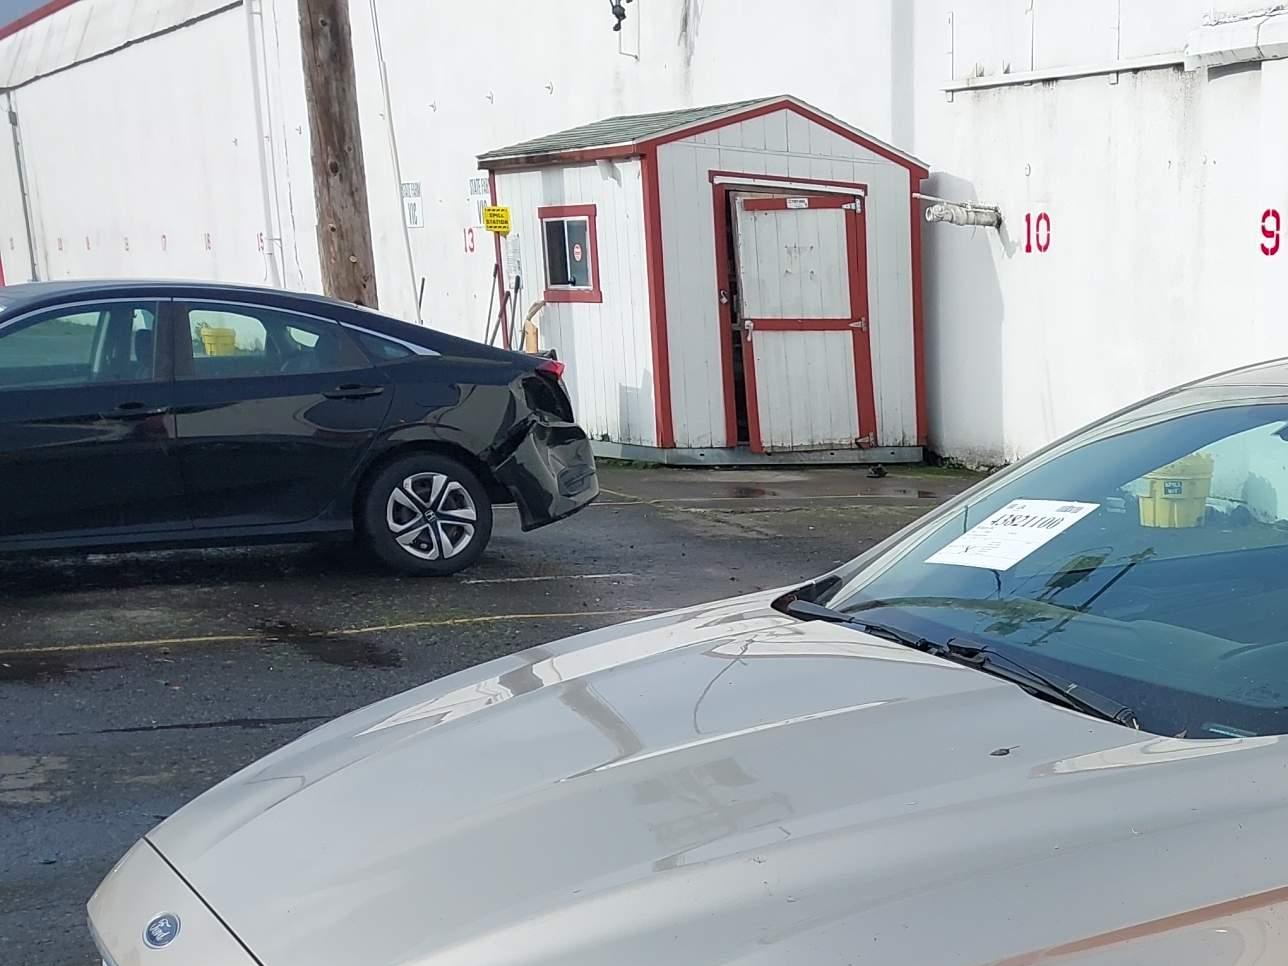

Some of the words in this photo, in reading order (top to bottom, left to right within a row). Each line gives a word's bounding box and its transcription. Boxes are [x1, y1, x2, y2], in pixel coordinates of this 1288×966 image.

[463, 228, 475, 252] 13
[1024, 213, 1051, 253] 10
[1259, 209, 1281, 256] 9
